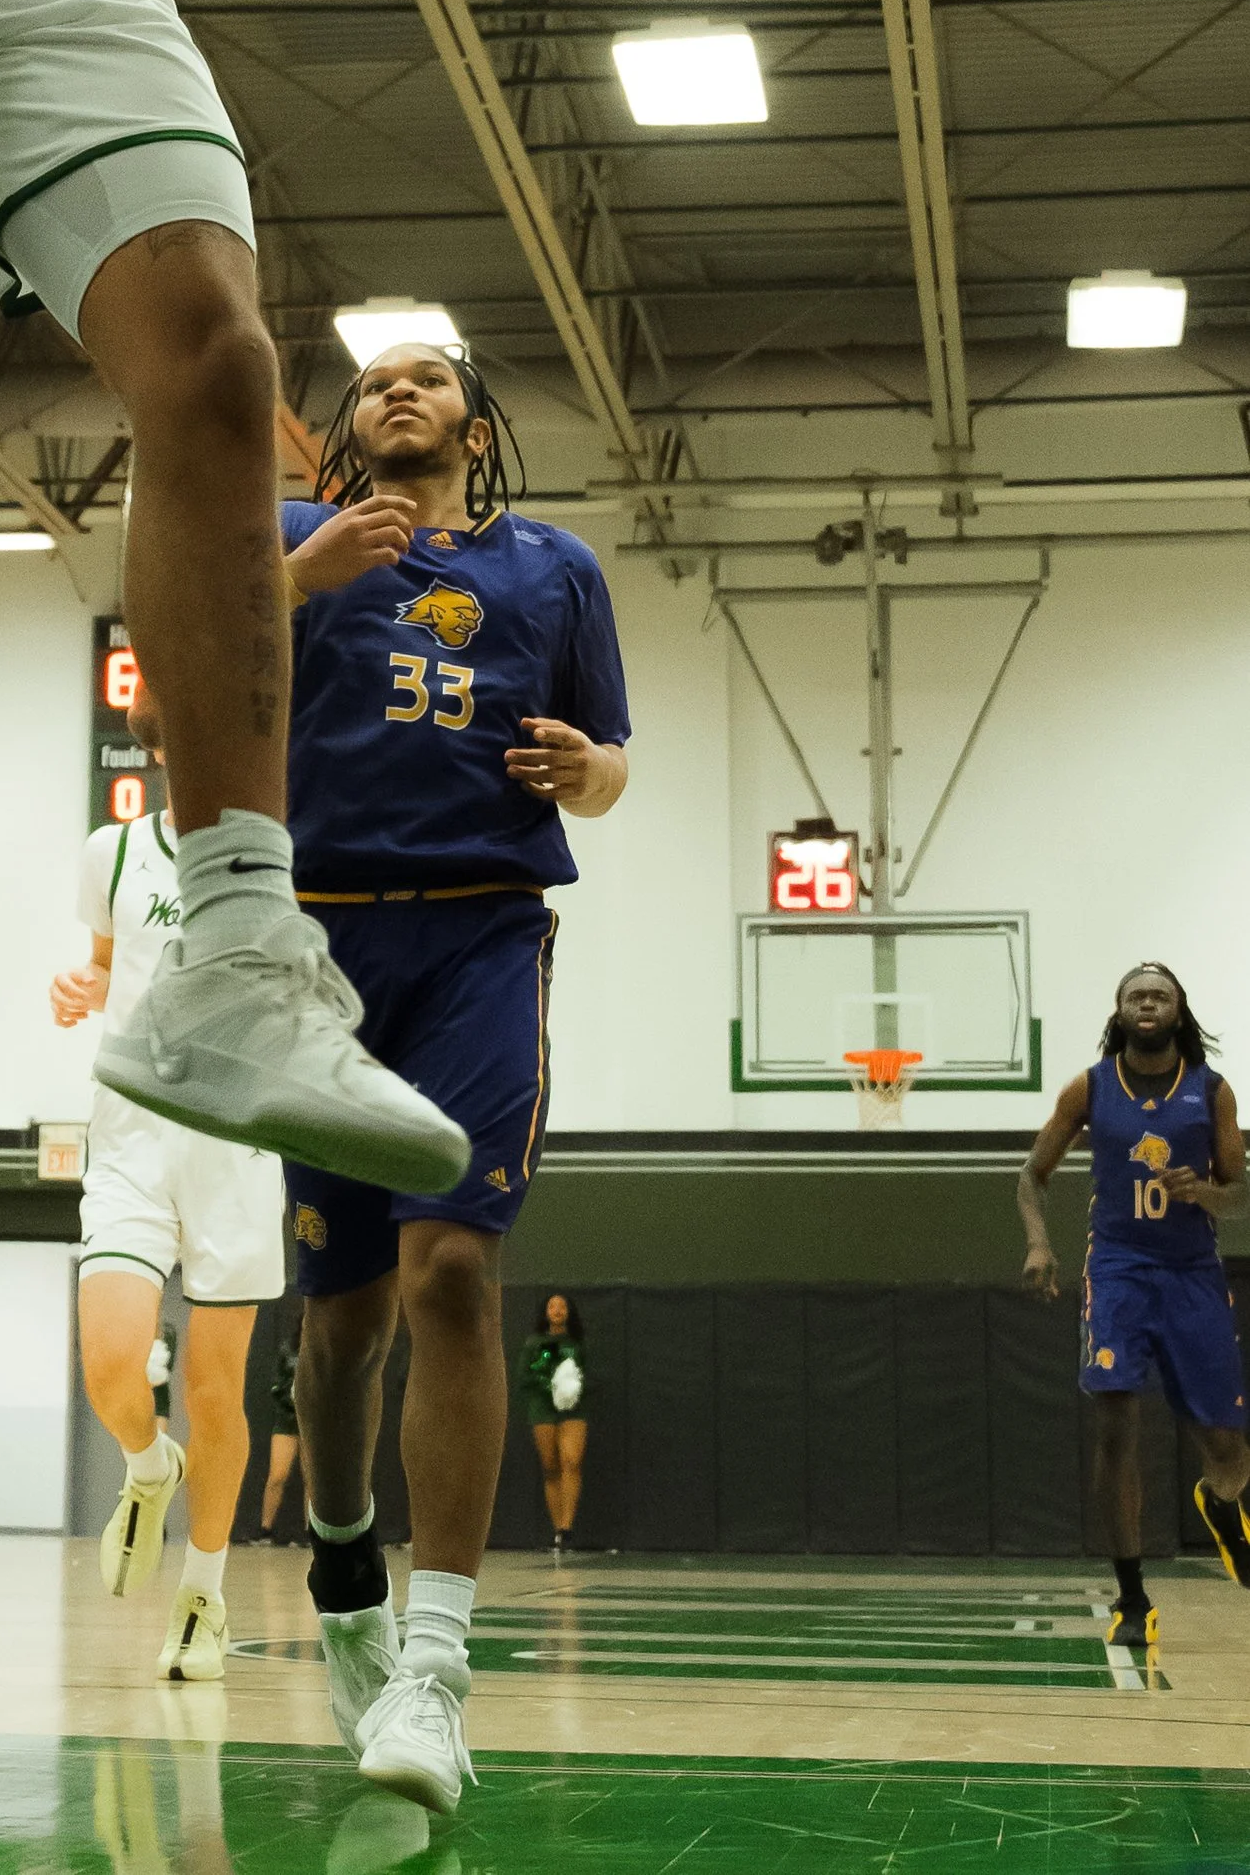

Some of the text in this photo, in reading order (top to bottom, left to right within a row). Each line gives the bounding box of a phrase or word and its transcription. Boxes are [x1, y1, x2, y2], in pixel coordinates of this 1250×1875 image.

[385, 651, 475, 731] 33
[112, 776, 145, 821] 0
[1133, 1178, 1168, 1220] 10
